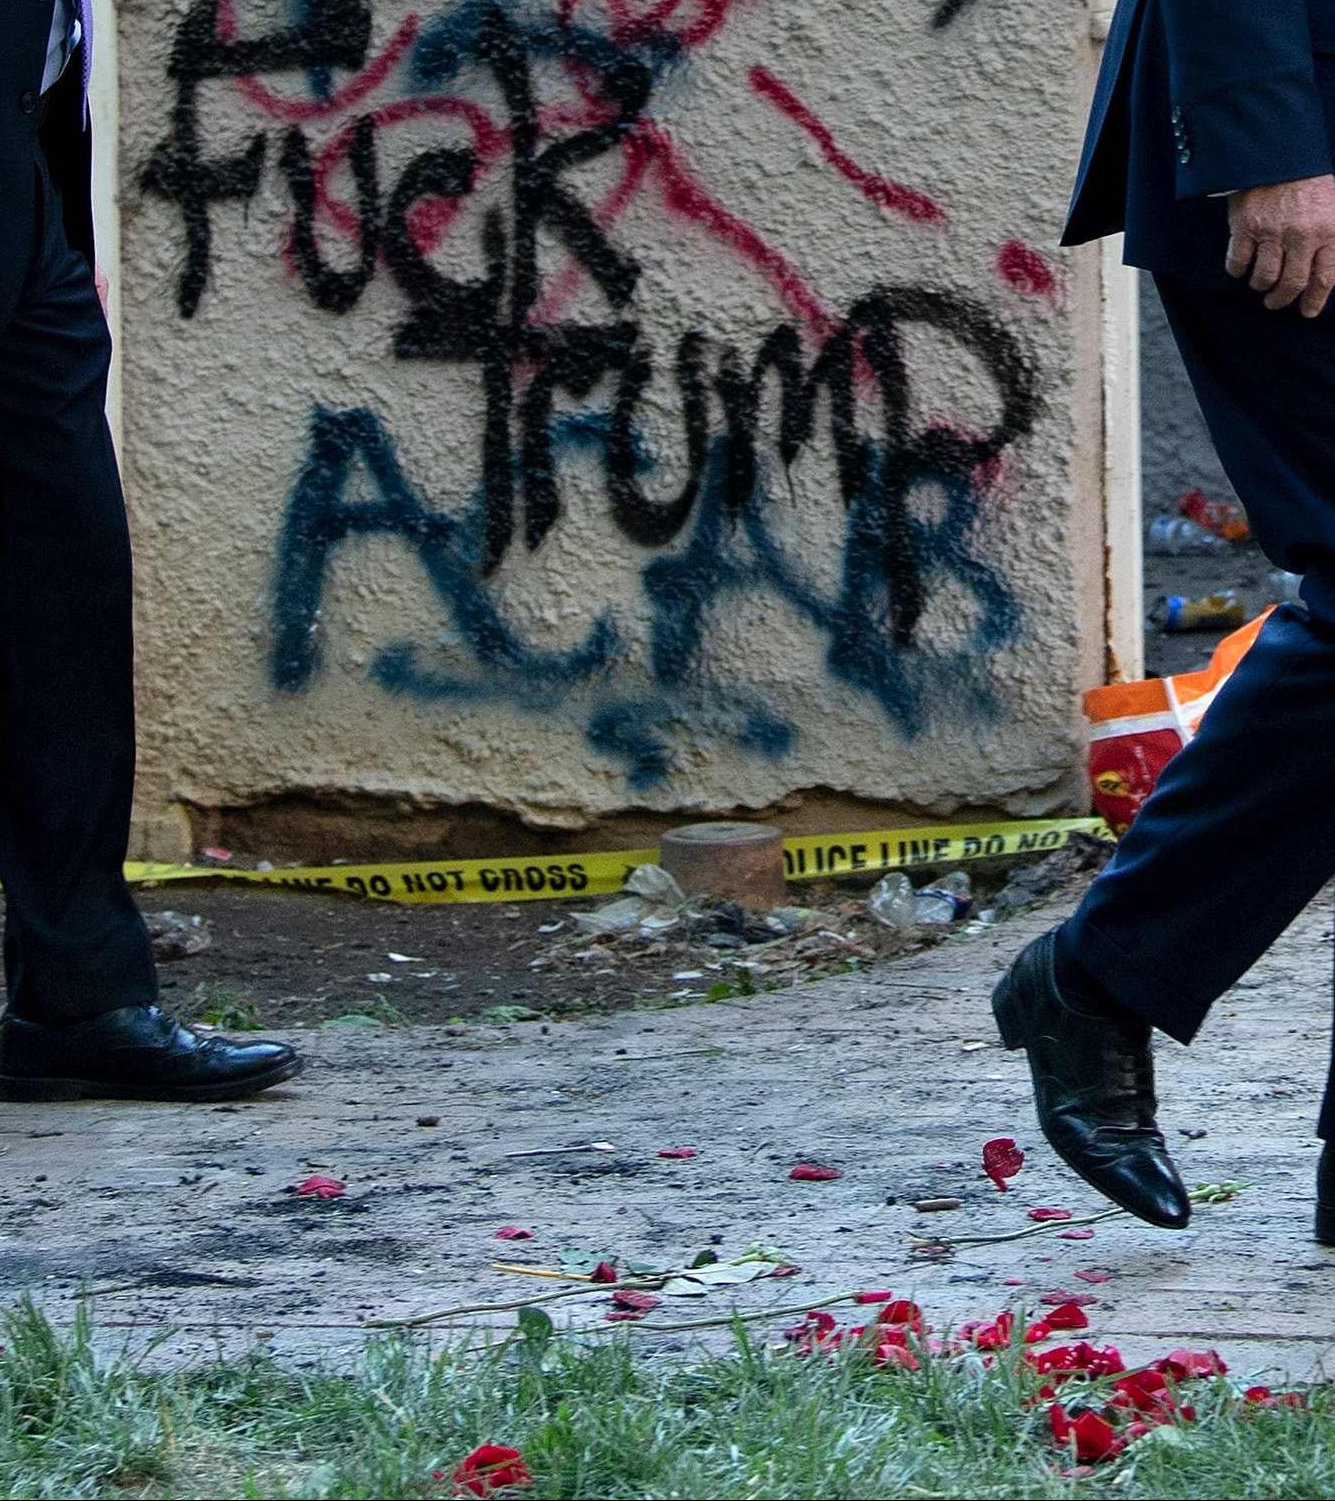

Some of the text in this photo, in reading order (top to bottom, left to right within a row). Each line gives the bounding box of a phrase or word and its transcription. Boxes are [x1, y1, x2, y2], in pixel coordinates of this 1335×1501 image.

[391, 282, 1054, 650] TRUMP
[401, 870, 466, 893] NOT
[478, 862, 589, 892] CROSS
